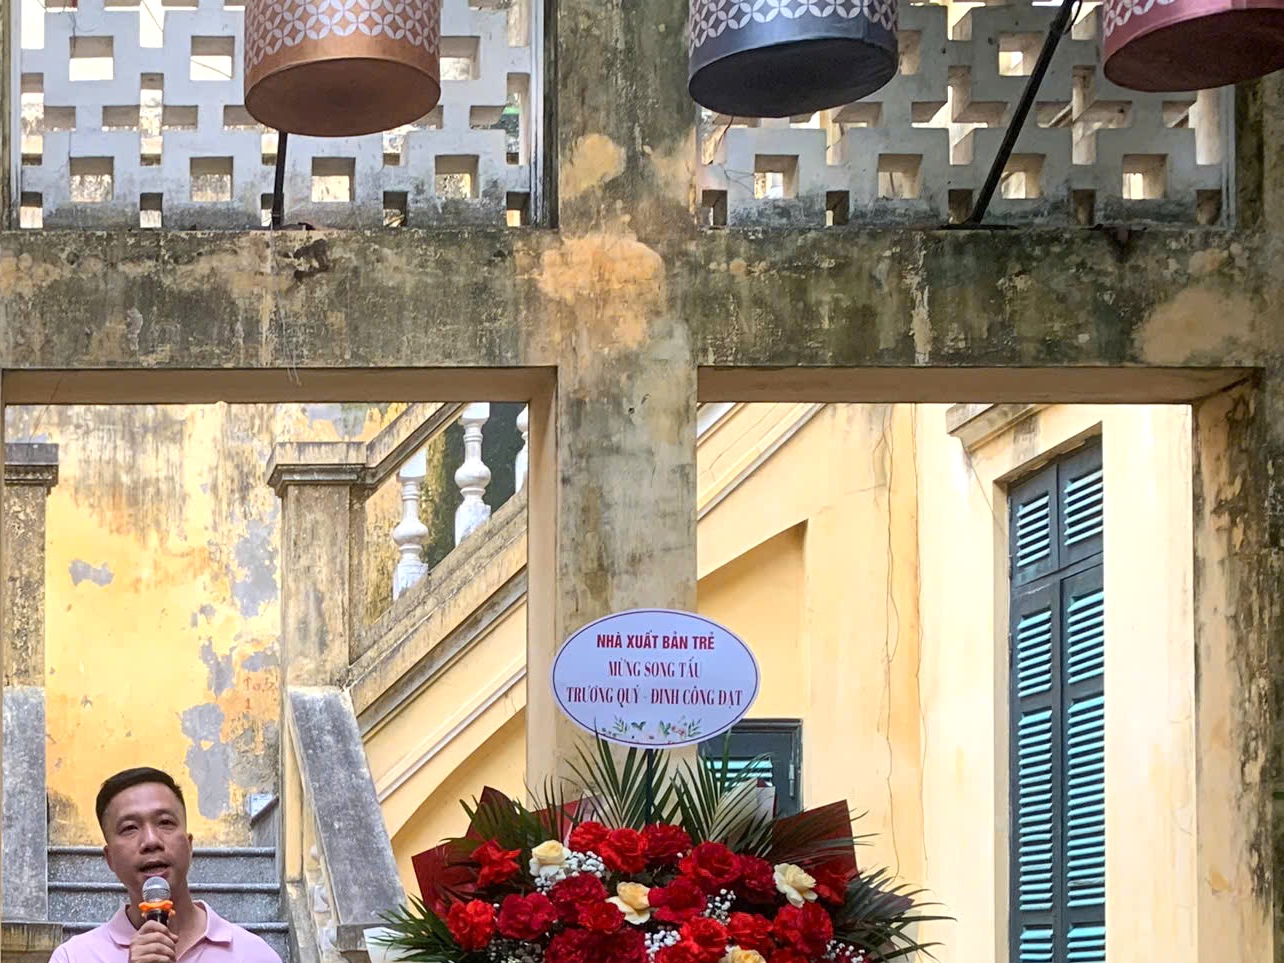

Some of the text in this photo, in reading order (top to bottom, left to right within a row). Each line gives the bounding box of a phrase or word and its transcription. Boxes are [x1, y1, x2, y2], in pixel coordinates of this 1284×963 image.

[597, 630, 715, 650] NHÀ XUẤT BẢN TRẺ
[608, 656, 701, 678] MỪNG SONG TẤU
[566, 684, 613, 704] TRƯƠNG
[617, 684, 640, 708] QUÝ
[683, 685, 714, 706] CÔNG
[718, 689, 743, 709] ĐẠT
